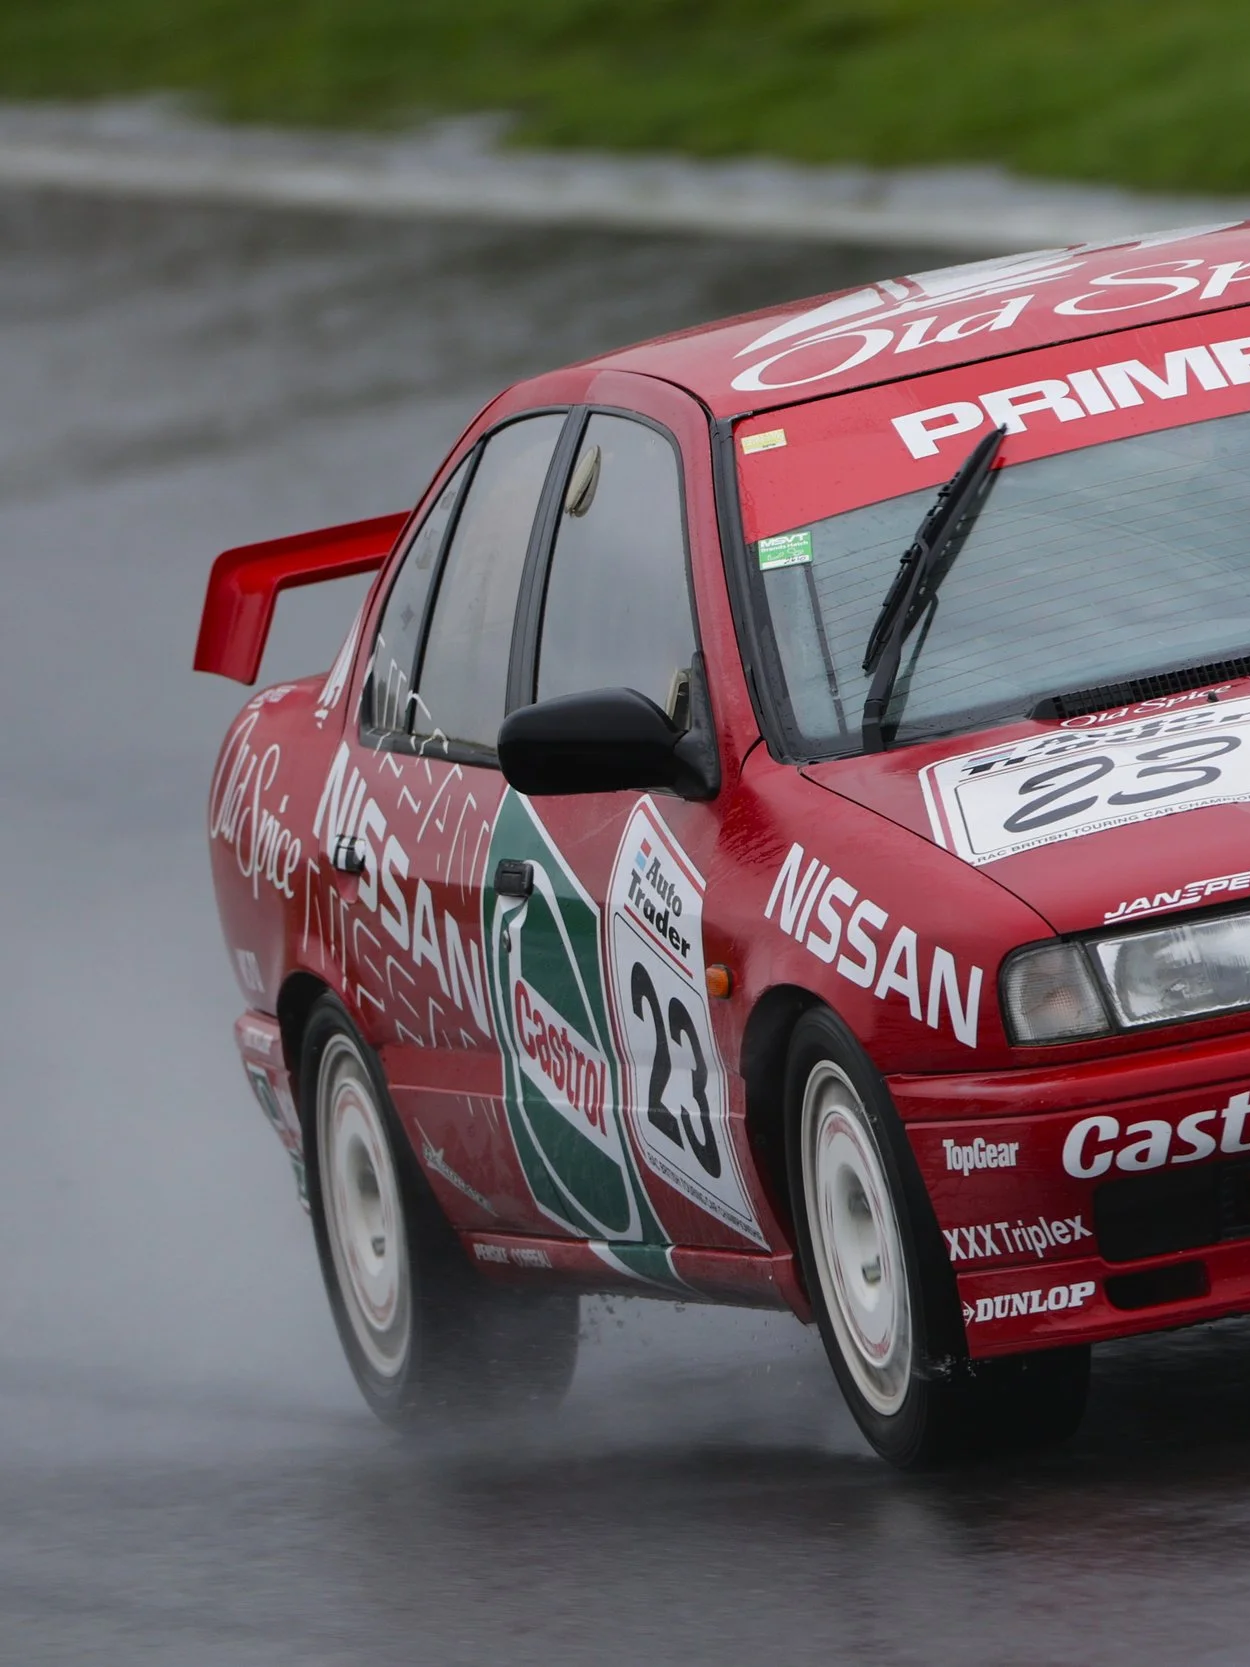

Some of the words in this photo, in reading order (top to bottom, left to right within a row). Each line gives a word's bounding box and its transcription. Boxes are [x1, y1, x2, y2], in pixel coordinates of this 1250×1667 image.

[731, 294, 1034, 392] Old
[761, 532, 809, 548] MSVT
[1060, 708, 1129, 729] Old
[1131, 684, 1232, 714] Spice
[210, 711, 257, 843] Old
[236, 743, 302, 900] Spice
[1003, 735, 1242, 833] 23
[977, 849, 1008, 864] RAC
[1011, 831, 1069, 853] BRITISH
[1074, 814, 1139, 835] TOURING
[1143, 807, 1175, 820] CAR
[313, 740, 492, 1049] NISSAN
[628, 867, 691, 959] Trader
[645, 856, 683, 918] Auto
[763, 842, 984, 1050] NISSAN
[514, 978, 609, 1136] Castrol
[631, 961, 722, 1180] 23
[974, 1280, 1096, 1323] DUNLOP
